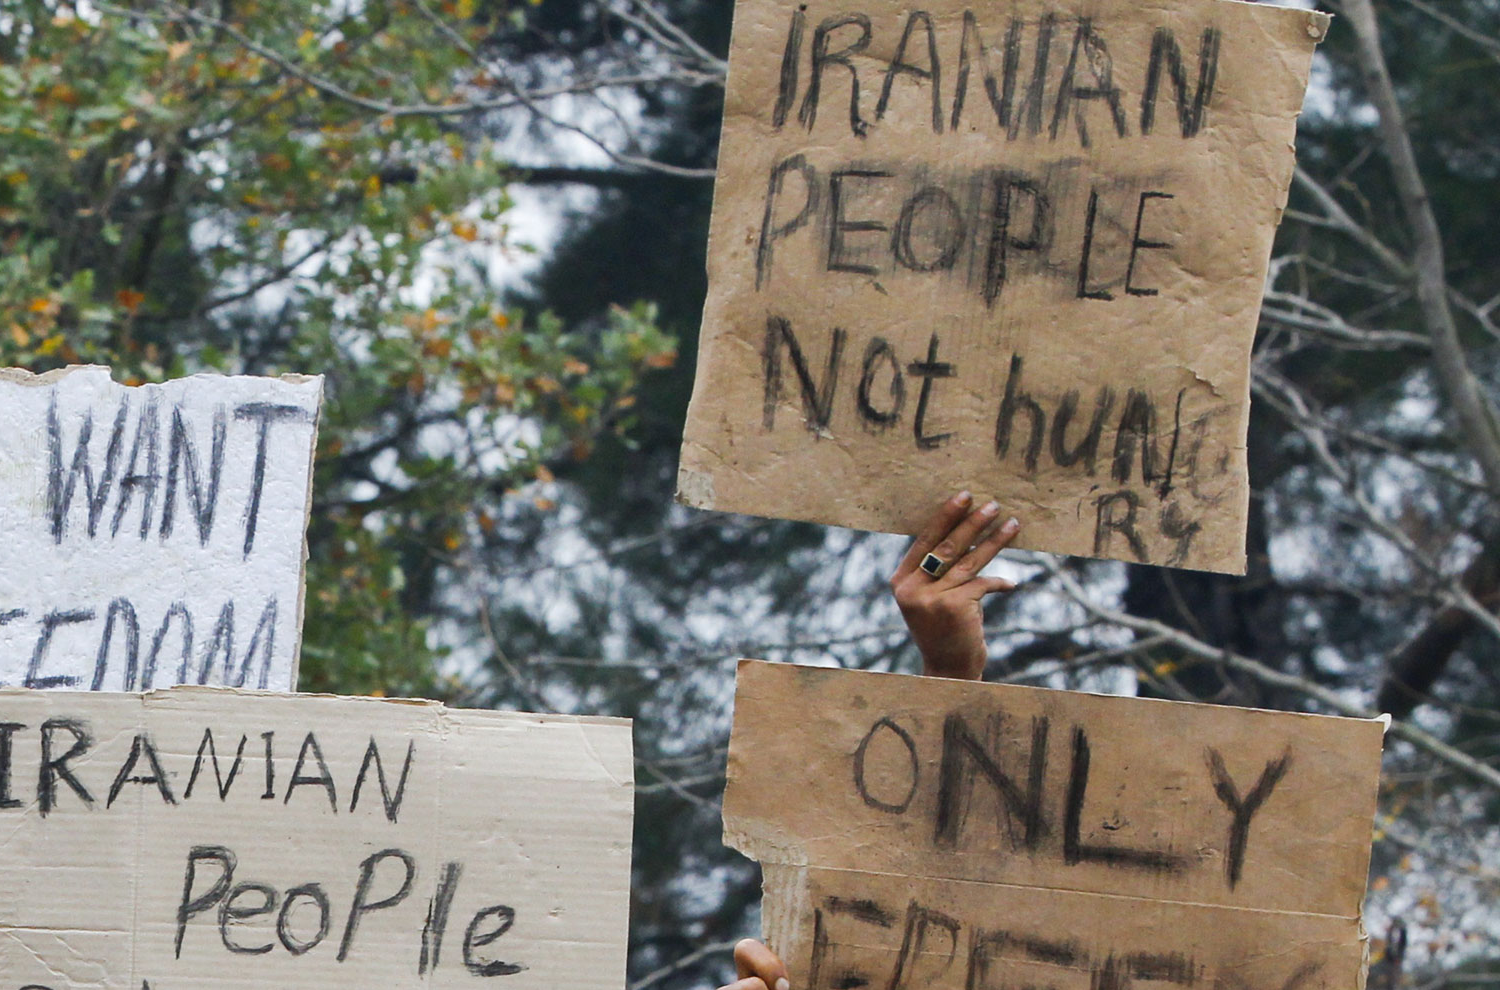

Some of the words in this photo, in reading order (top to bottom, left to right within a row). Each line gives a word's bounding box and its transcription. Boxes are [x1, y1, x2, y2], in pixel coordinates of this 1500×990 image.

[772, 4, 1221, 148] IRANIAN
[755, 154, 1176, 309] PEOPLE
[45, 391, 316, 561] WANT
[853, 712, 1293, 893] ONLY
